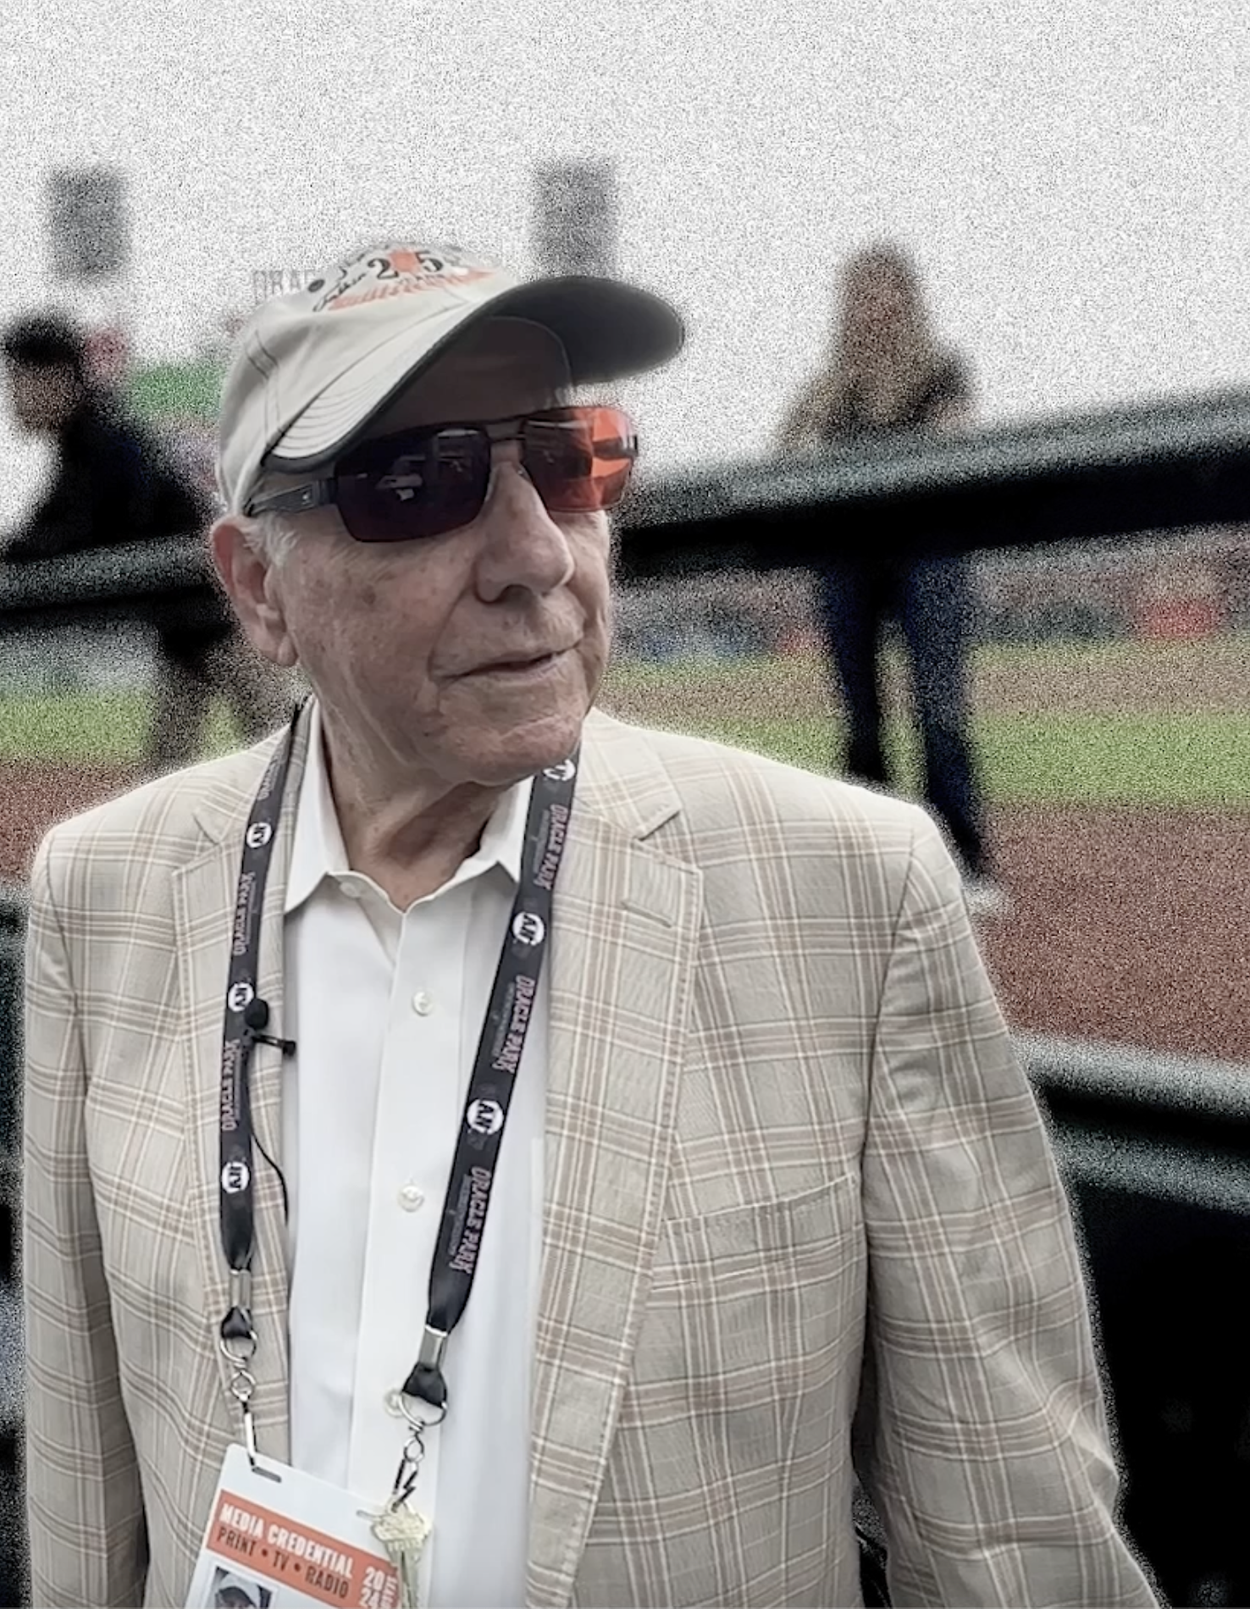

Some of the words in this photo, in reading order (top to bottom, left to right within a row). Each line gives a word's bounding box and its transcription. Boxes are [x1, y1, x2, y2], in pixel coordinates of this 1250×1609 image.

[548, 804, 568, 853] ORACLE
[533, 853, 558, 890] PARK
[511, 975, 535, 1032] ORACLE
[492, 1033, 522, 1073] PARK
[466, 1166, 491, 1229] ORACLE
[449, 1229, 480, 1273] PARK
[217, 1527, 256, 1556] PRINT
[273, 1552, 289, 1571] TV
[305, 1565, 349, 1598] RADIO
[220, 1504, 263, 1538] MEDIA
[268, 1524, 353, 1578] CREDENTIAL
[363, 1566, 385, 1591] 20
